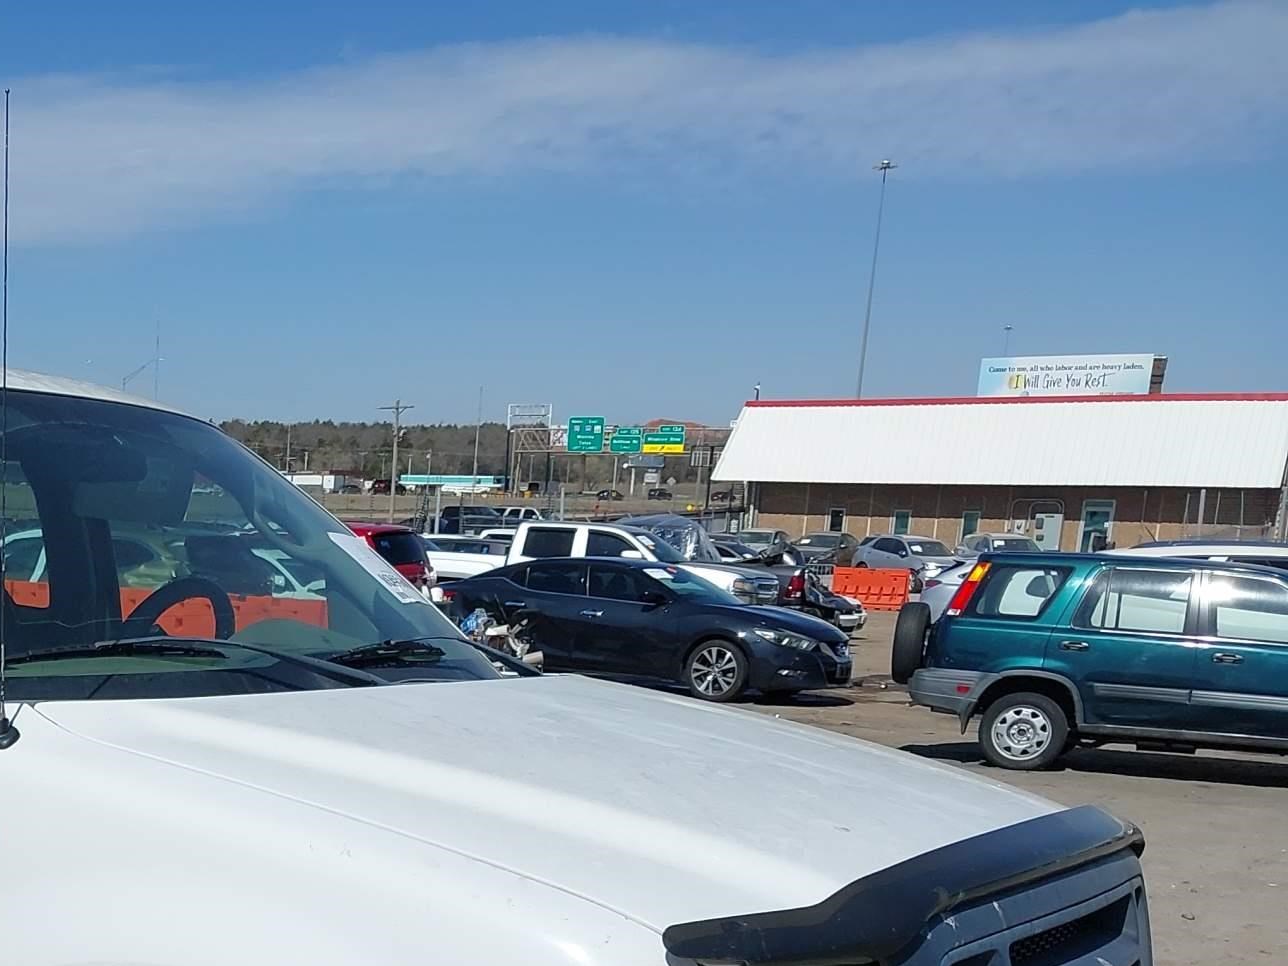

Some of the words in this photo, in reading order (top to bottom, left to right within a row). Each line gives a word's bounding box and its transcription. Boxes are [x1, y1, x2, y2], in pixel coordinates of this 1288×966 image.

[988, 365, 1007, 373] Come
[1029, 364, 1039, 372] all
[1102, 363, 1122, 371] heavy
[1014, 374, 1023, 389] I
[1023, 374, 1040, 389] Will
[1042, 373, 1062, 389] Give
[1065, 373, 1082, 389] You
